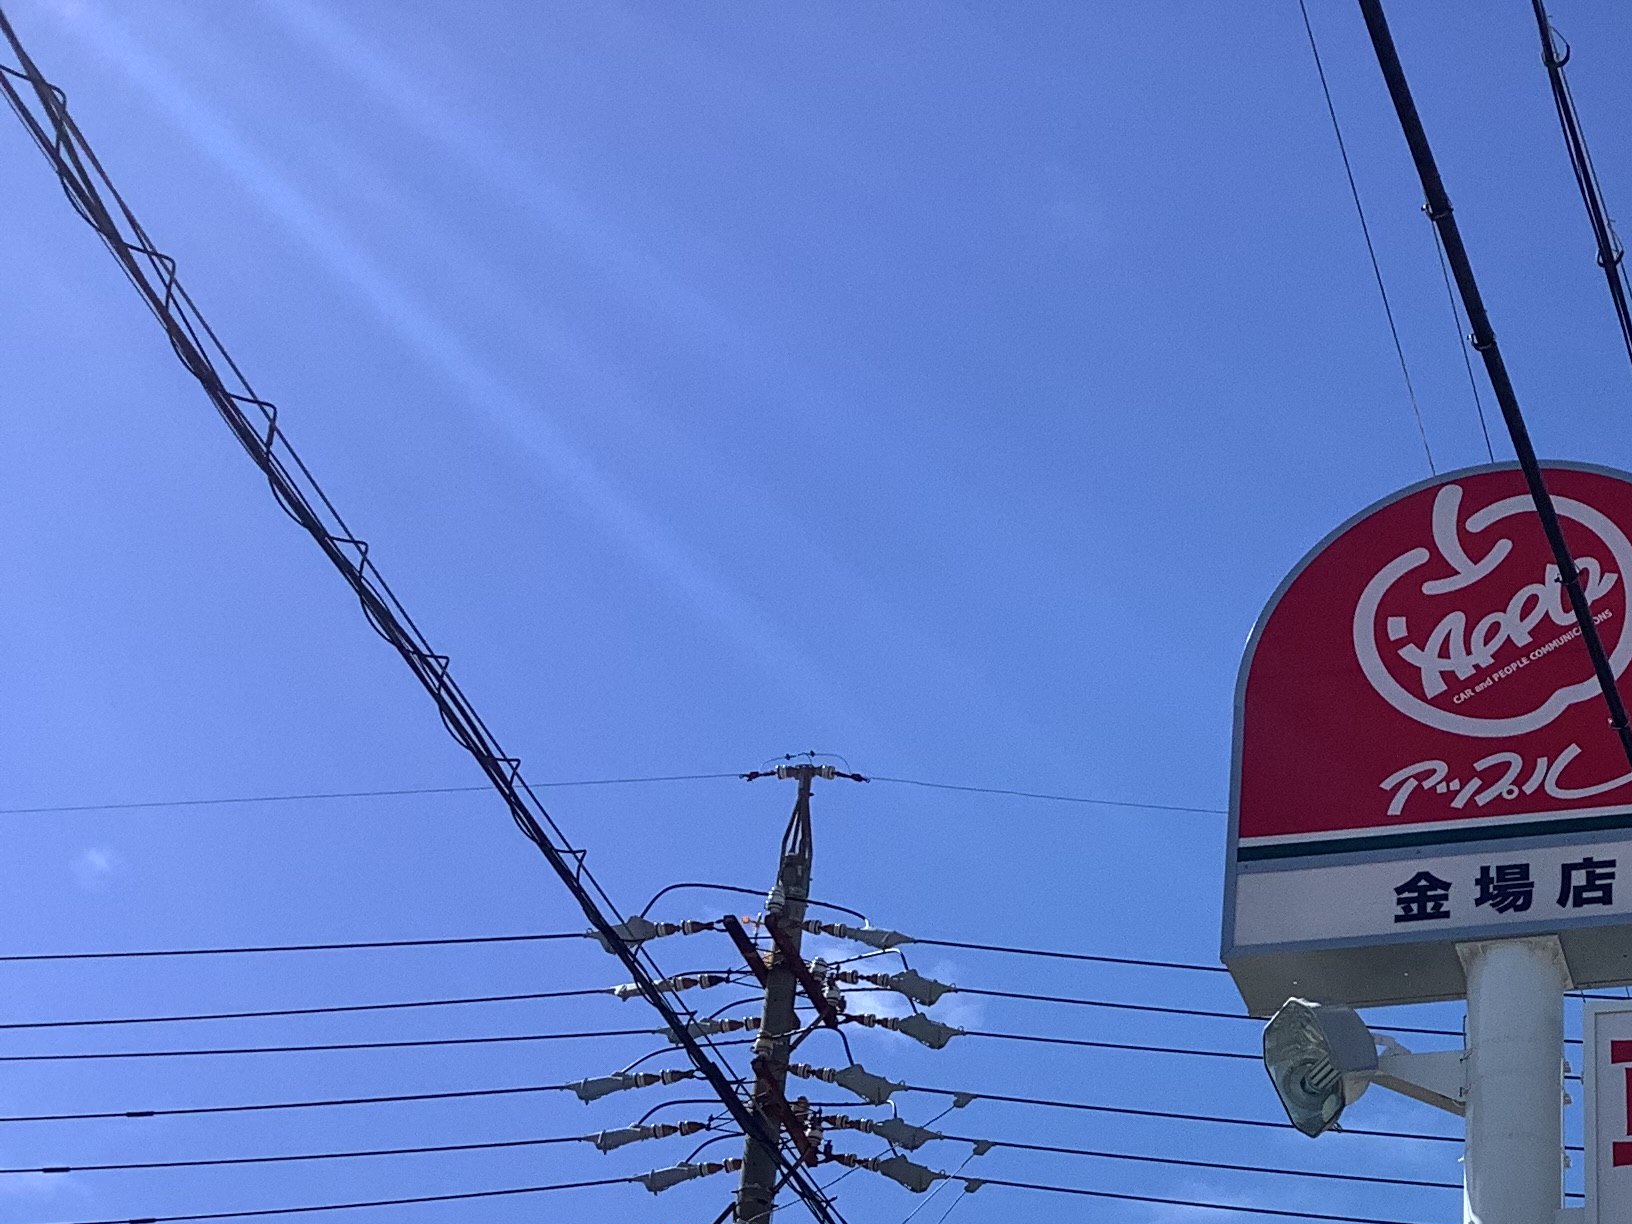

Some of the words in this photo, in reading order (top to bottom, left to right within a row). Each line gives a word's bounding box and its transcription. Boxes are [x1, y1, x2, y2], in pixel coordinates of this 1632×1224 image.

[1397, 556, 1618, 699] Apple
[1453, 688, 1475, 704] CAR
[1474, 676, 1493, 693] and
[1493, 657, 1530, 682] PEOPLE
[1530, 608, 1613, 661] COMMUNICONS
[1394, 856, 1617, 923] 金場店
